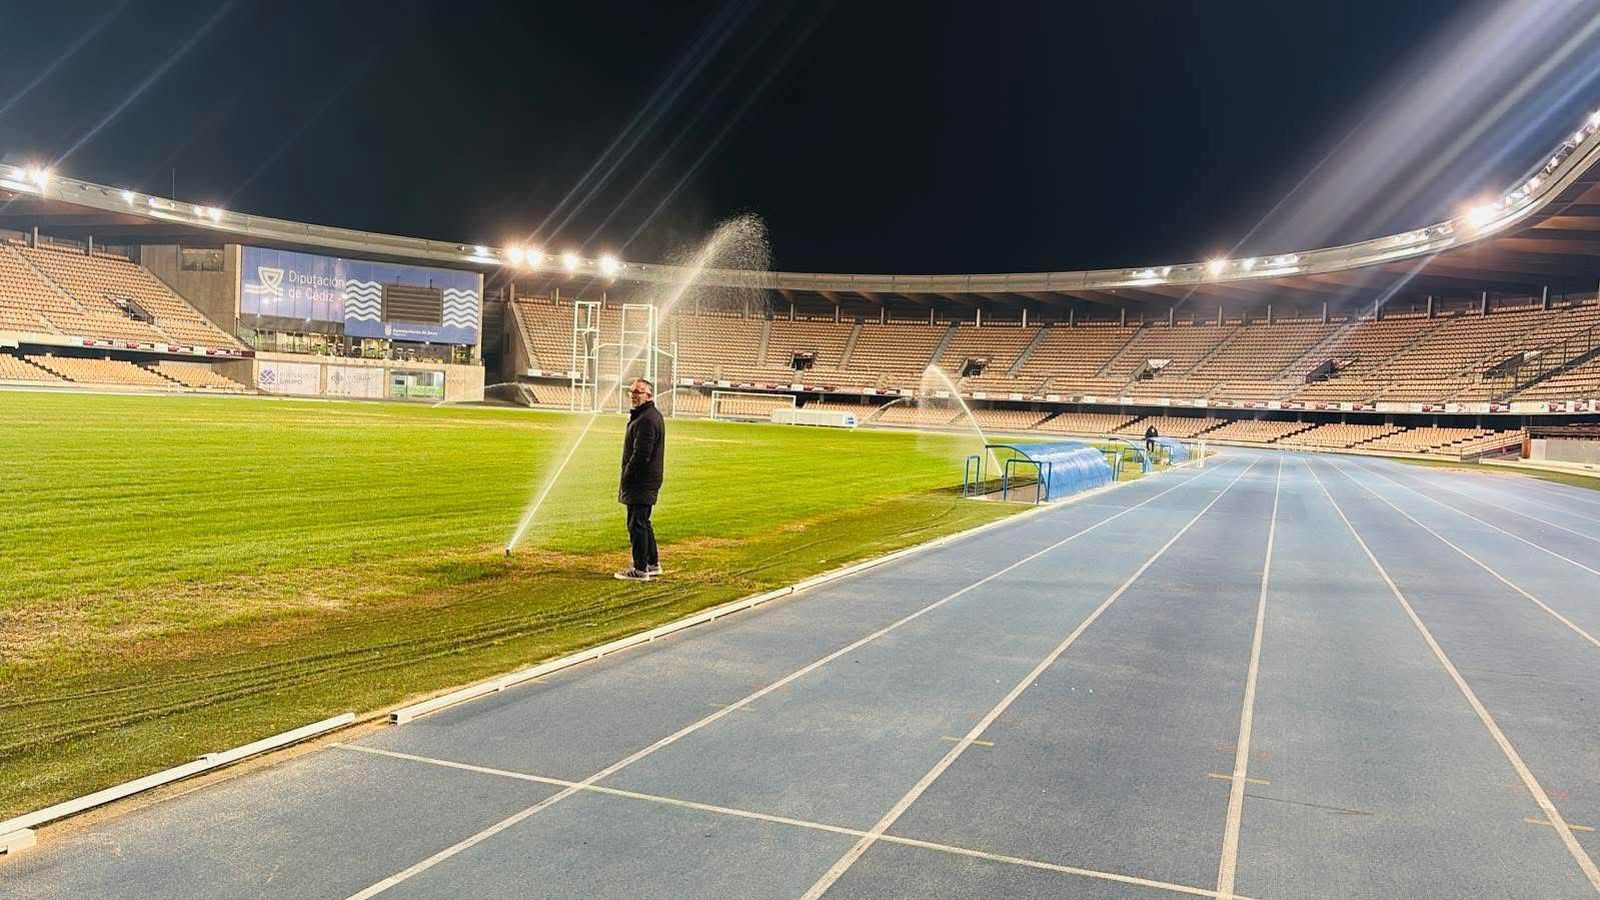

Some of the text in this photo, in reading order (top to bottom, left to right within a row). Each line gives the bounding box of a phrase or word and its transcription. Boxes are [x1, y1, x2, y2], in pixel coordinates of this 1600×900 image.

[288, 270, 346, 288] Diputación
[288, 284, 335, 302] de Cádiz
